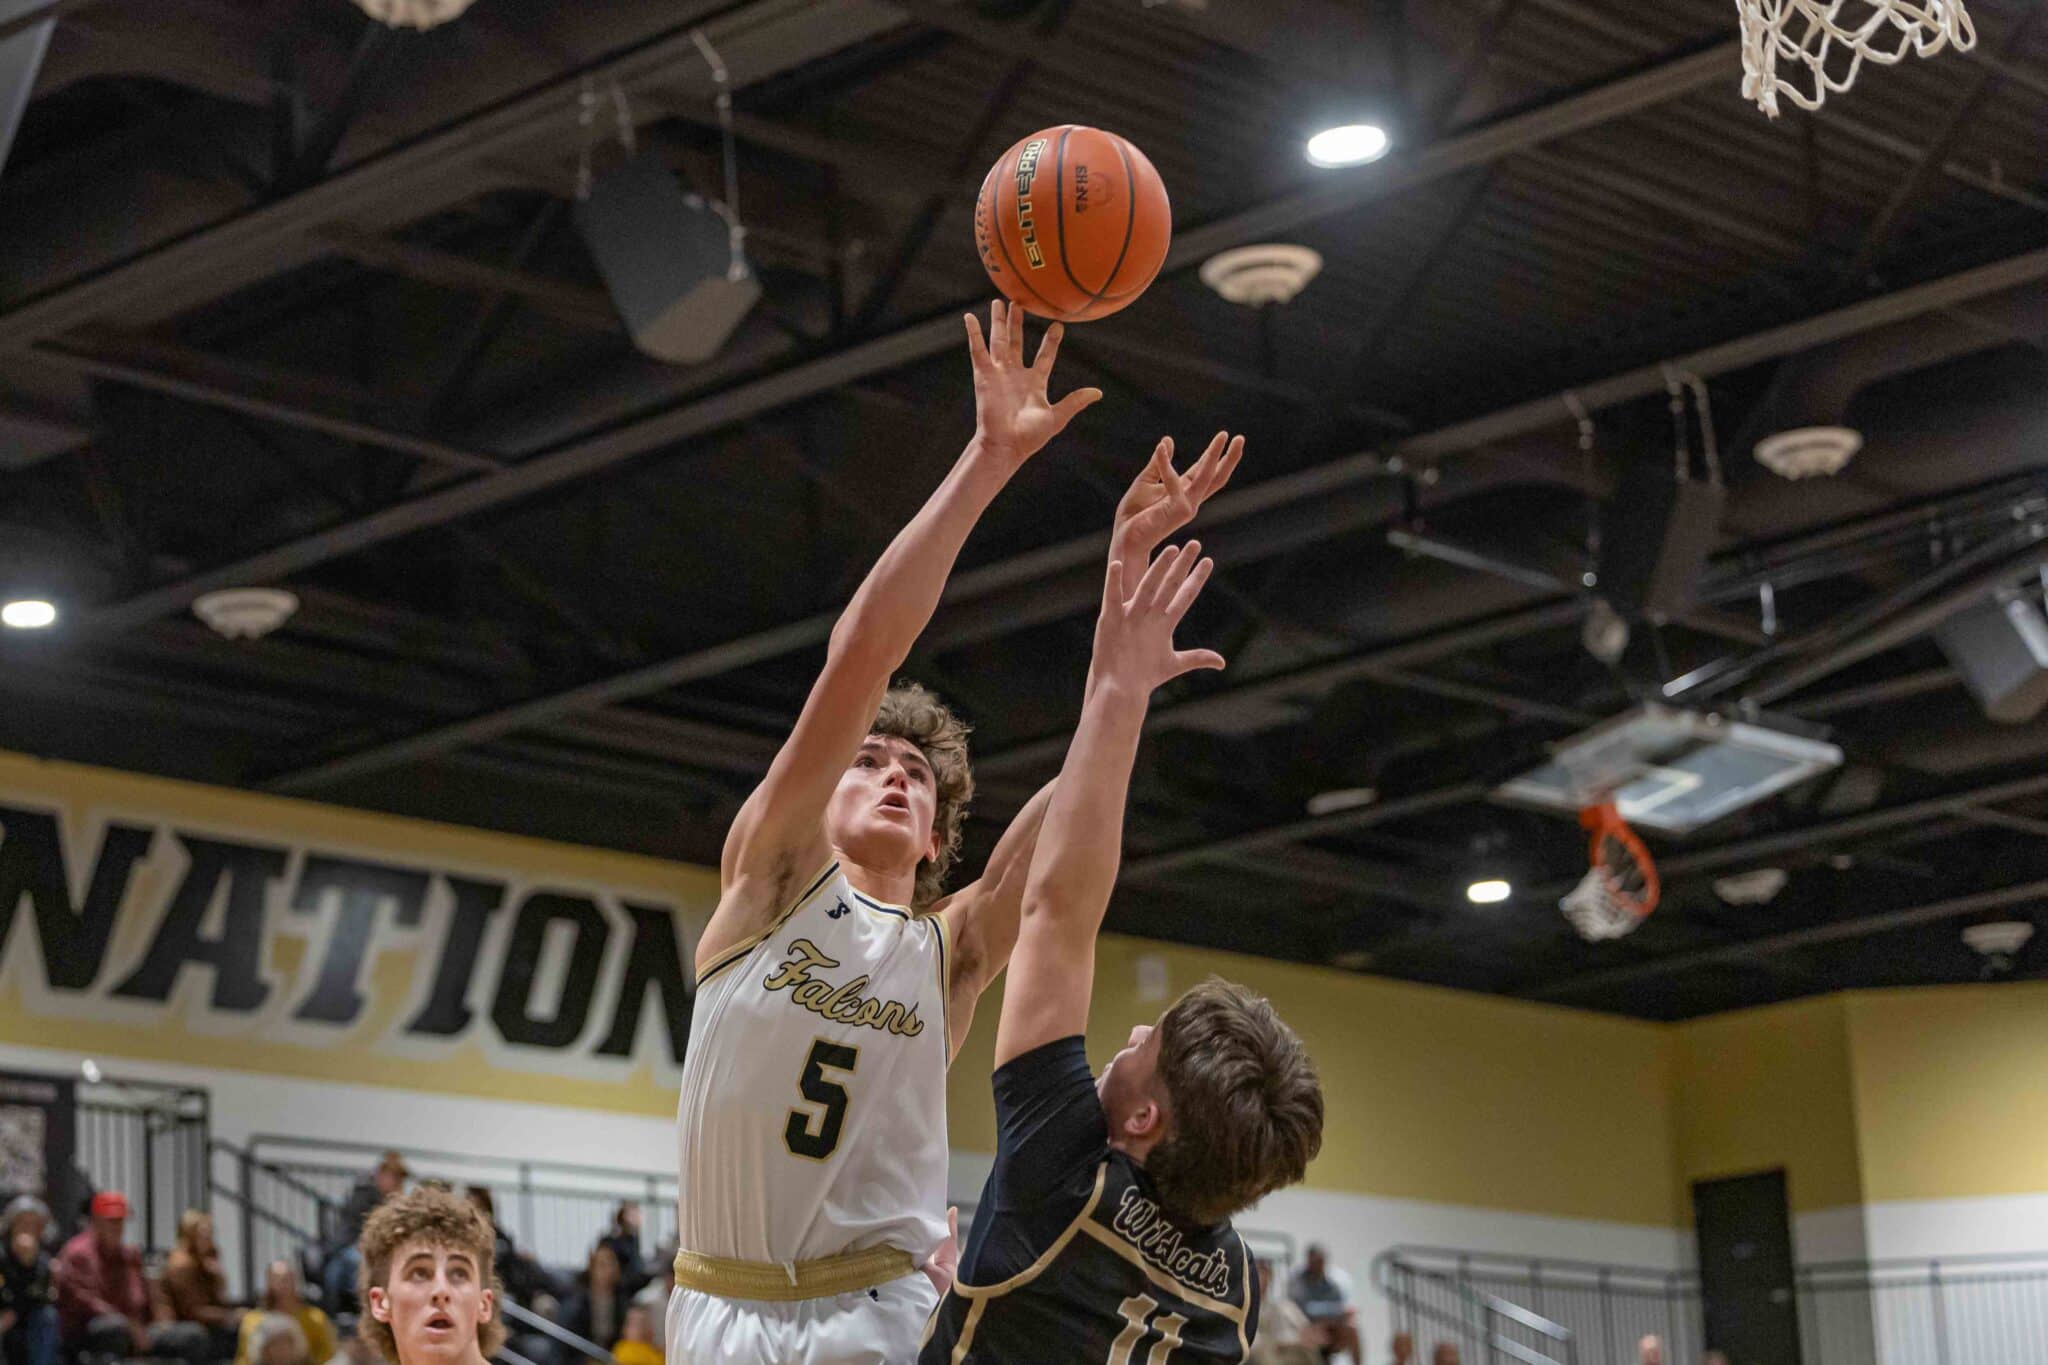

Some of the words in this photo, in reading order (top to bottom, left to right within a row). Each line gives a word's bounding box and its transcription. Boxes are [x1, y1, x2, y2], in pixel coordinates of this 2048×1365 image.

[1018, 139, 1046, 175] PRO
[1017, 174, 1045, 269] ELITE
[0, 807, 697, 1064] NATION
[763, 938, 925, 1037] Falcons
[782, 1036, 861, 1164] 5
[1113, 1185, 1230, 1297] Wildcats
